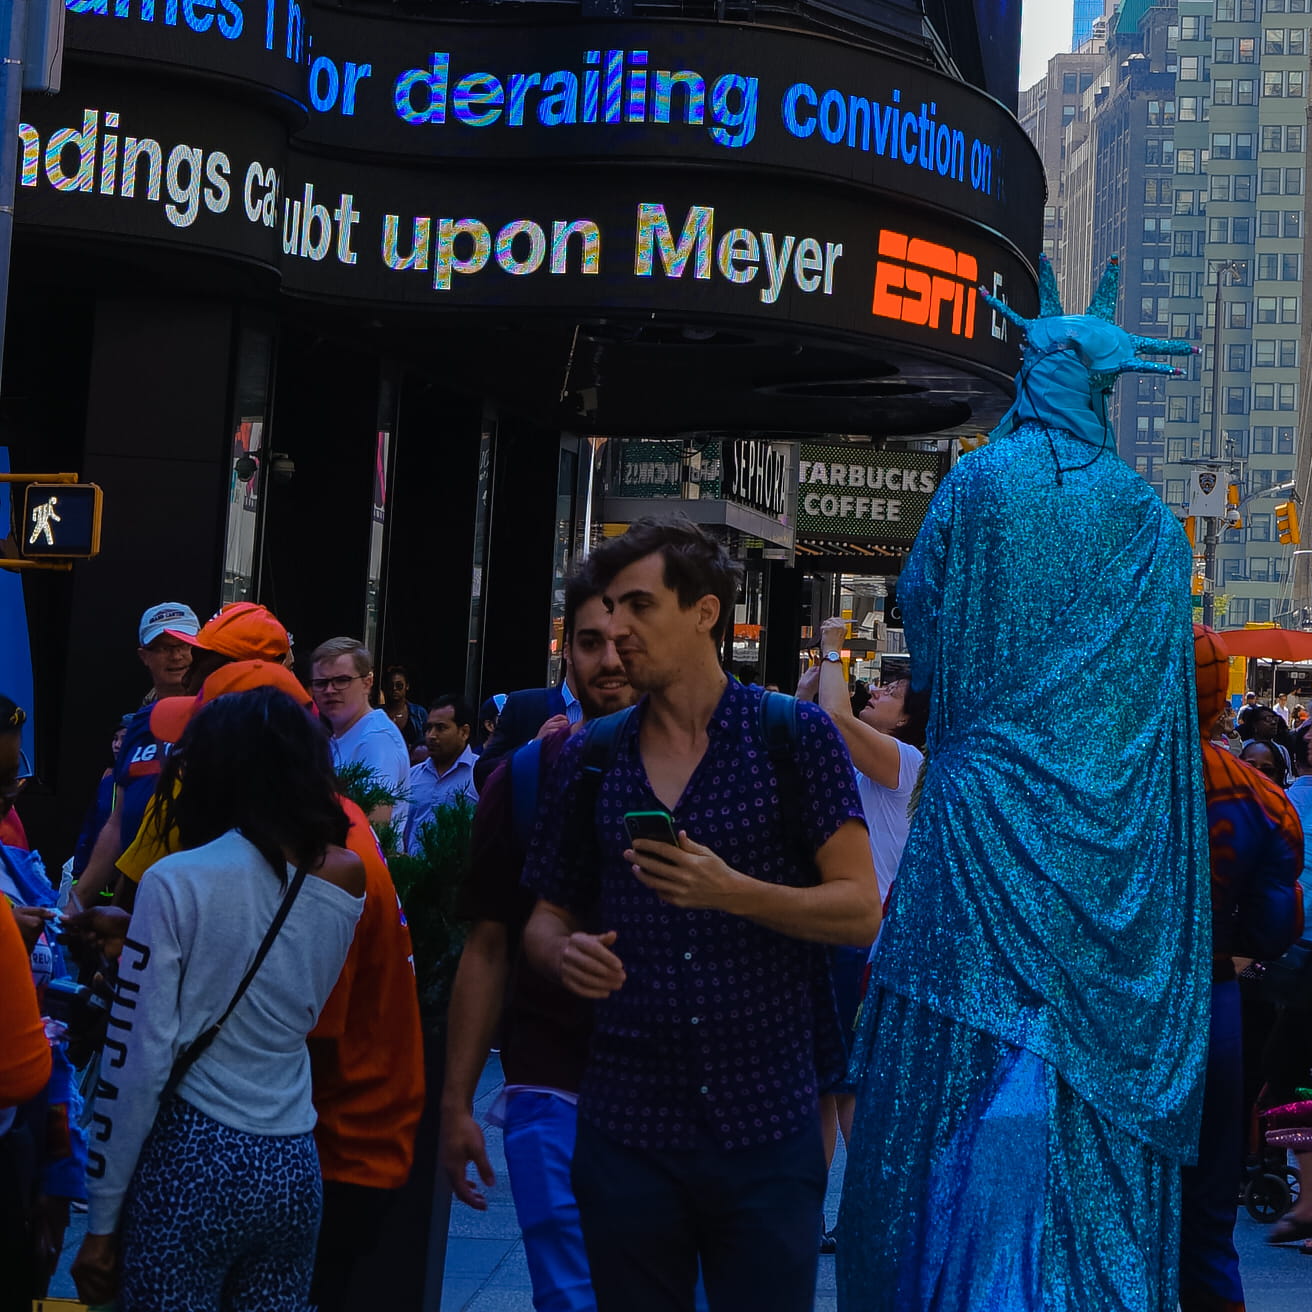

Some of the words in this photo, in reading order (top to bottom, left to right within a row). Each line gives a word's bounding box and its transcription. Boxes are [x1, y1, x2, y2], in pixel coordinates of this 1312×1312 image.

[393, 49, 759, 148] derailing
[782, 81, 966, 183] conviction
[969, 135, 992, 196] on
[381, 216, 601, 290] upon
[634, 202, 843, 304] Meyer
[872, 228, 978, 340] ESPN
[732, 439, 787, 514] SEPHORA
[803, 493, 901, 522] COFFEE
